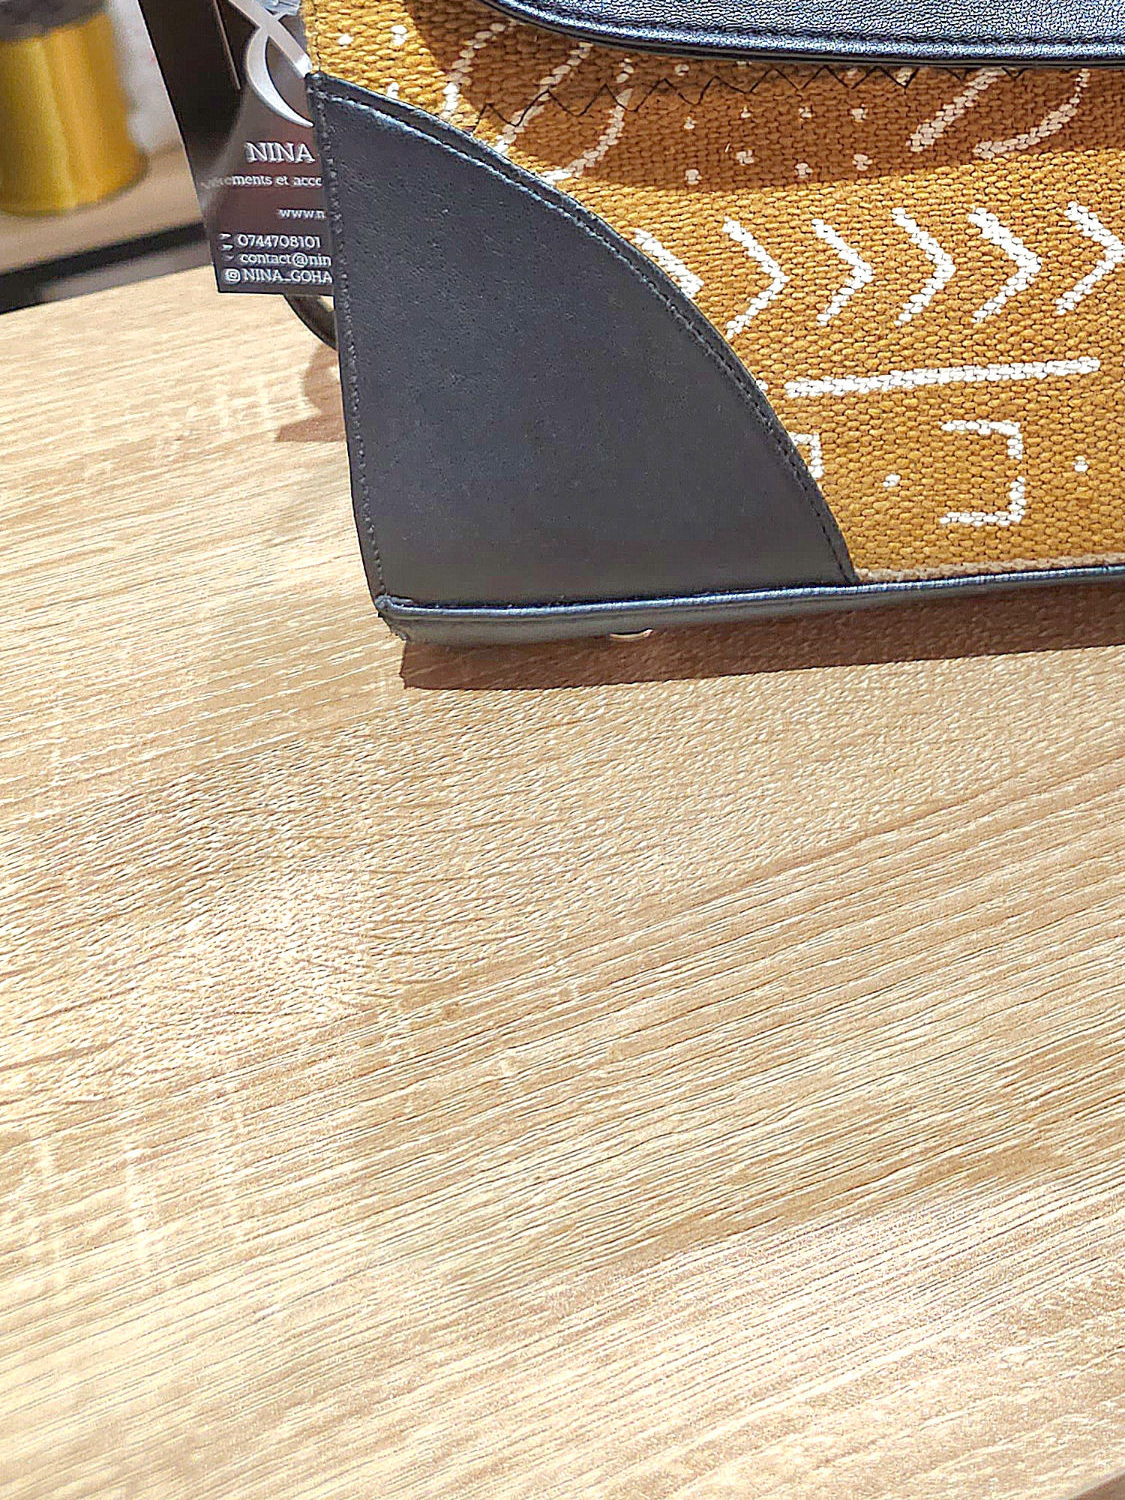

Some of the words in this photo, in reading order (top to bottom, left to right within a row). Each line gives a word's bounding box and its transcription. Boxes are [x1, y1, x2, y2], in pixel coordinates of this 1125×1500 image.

[245, 141, 316, 164] NINA
[201, 174, 273, 189] Vtements
[276, 176, 289, 187] et
[238, 234, 322, 249] 0744708101
[240, 252, 332, 268] contact@nin
[243, 268, 333, 285] NINA_GOHA
